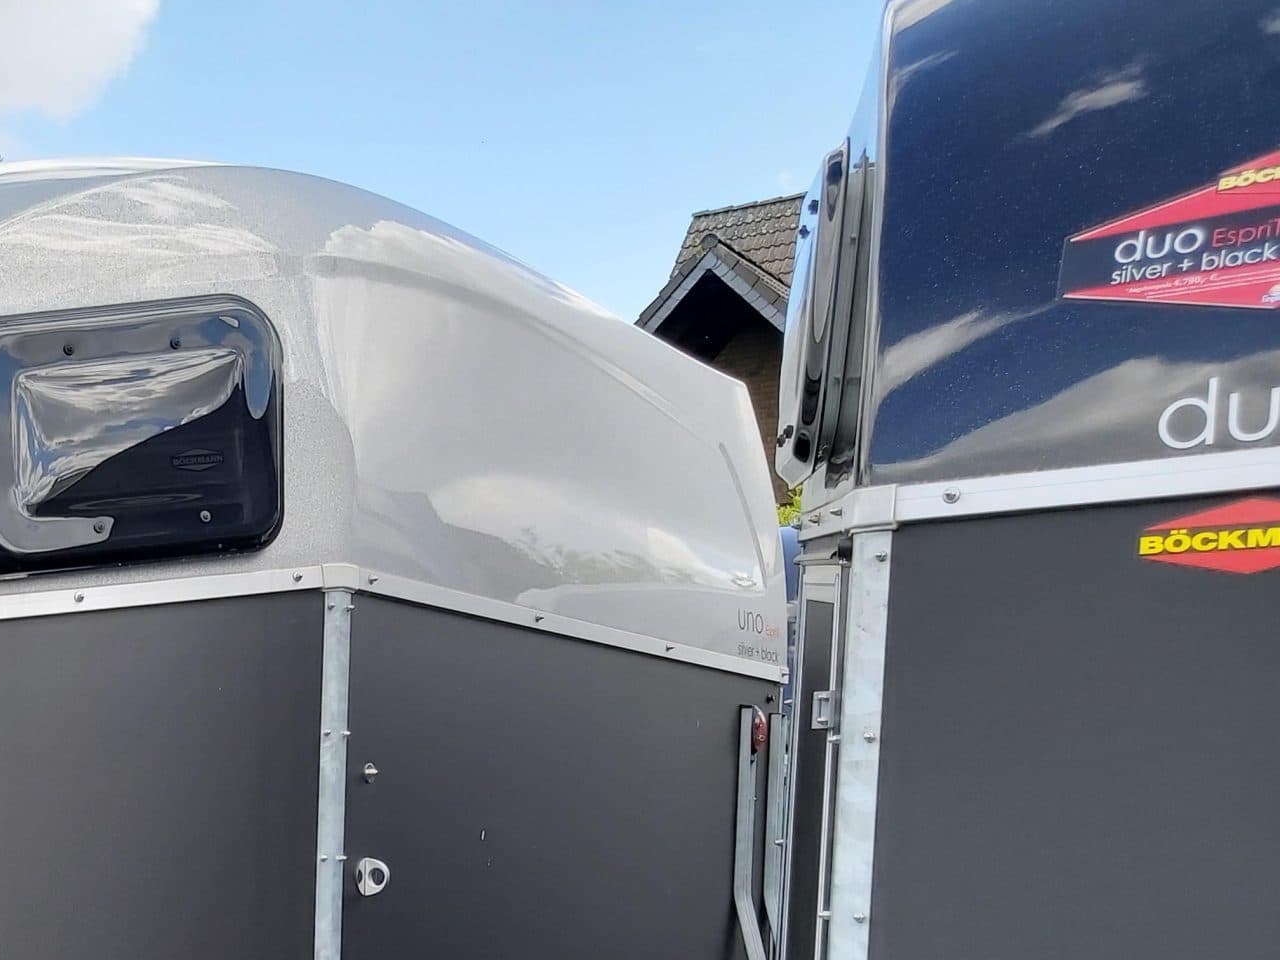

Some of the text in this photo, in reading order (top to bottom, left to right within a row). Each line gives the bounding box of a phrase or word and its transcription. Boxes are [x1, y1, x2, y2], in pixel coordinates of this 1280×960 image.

[1218, 166, 1280, 192] BÖC
[1114, 228, 1205, 264] duo
[1110, 262, 1173, 285] silver
[1201, 242, 1280, 272] black
[1139, 526, 1280, 555] BÖCKM
[738, 607, 764, 634] uno
